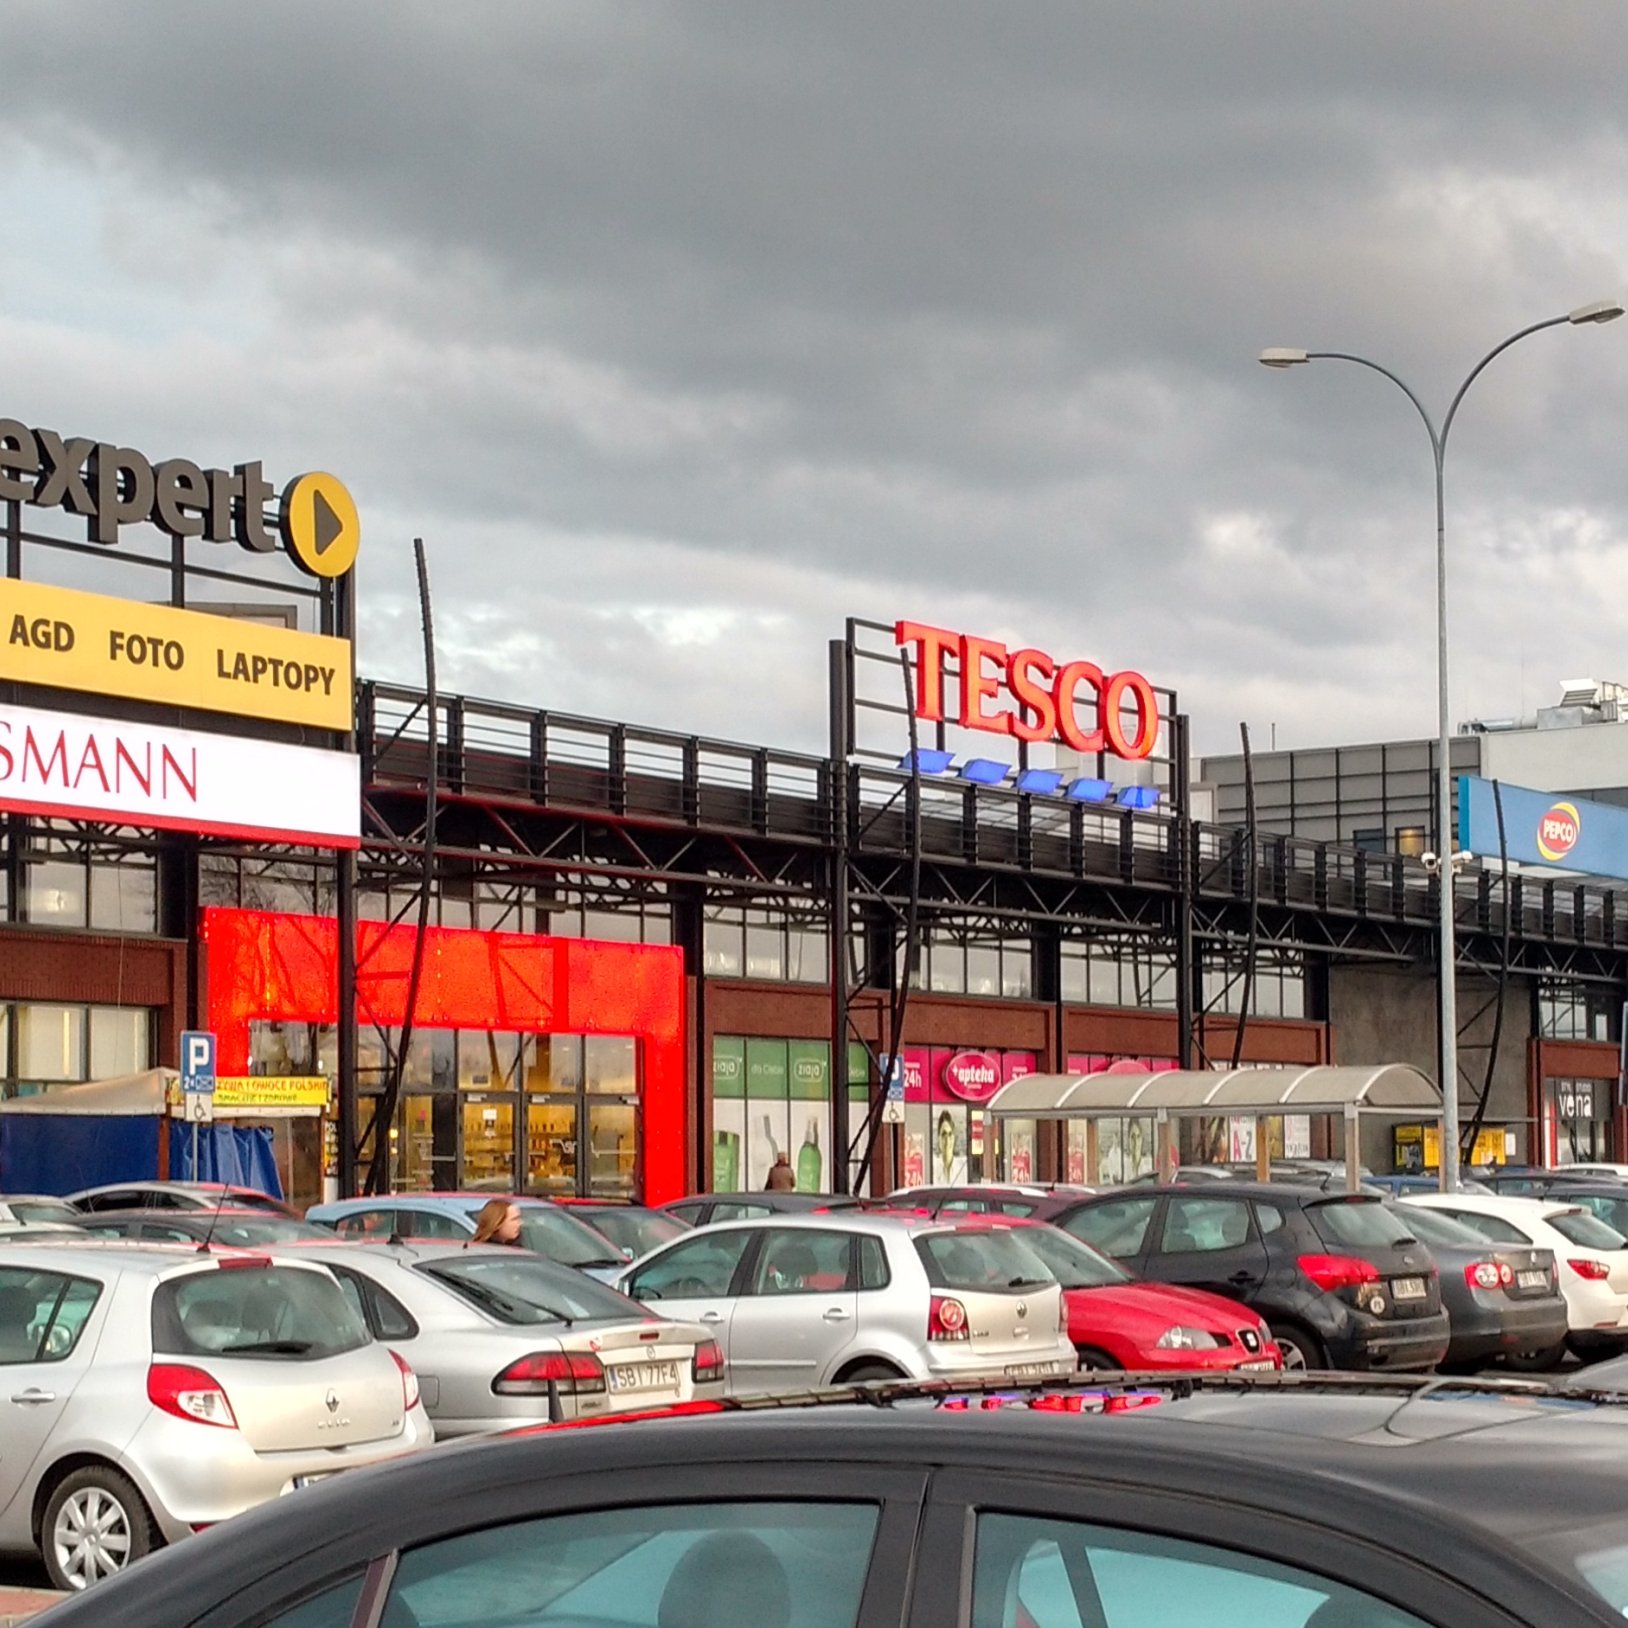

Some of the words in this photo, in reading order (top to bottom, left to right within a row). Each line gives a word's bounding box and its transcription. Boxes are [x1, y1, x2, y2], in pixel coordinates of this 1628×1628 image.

[0, 418, 275, 553] expert
[8, 613, 75, 653] AGD
[109, 630, 185, 671] FOTO
[216, 648, 335, 696] LAPTOPY
[895, 620, 1159, 760] TESCO
[1543, 820, 1574, 843] PEPCO
[189, 1037, 210, 1075] P
[798, 1064, 820, 1079] ziaja
[904, 1069, 922, 1088] 24h
[1558, 1094, 1592, 1118] vena
